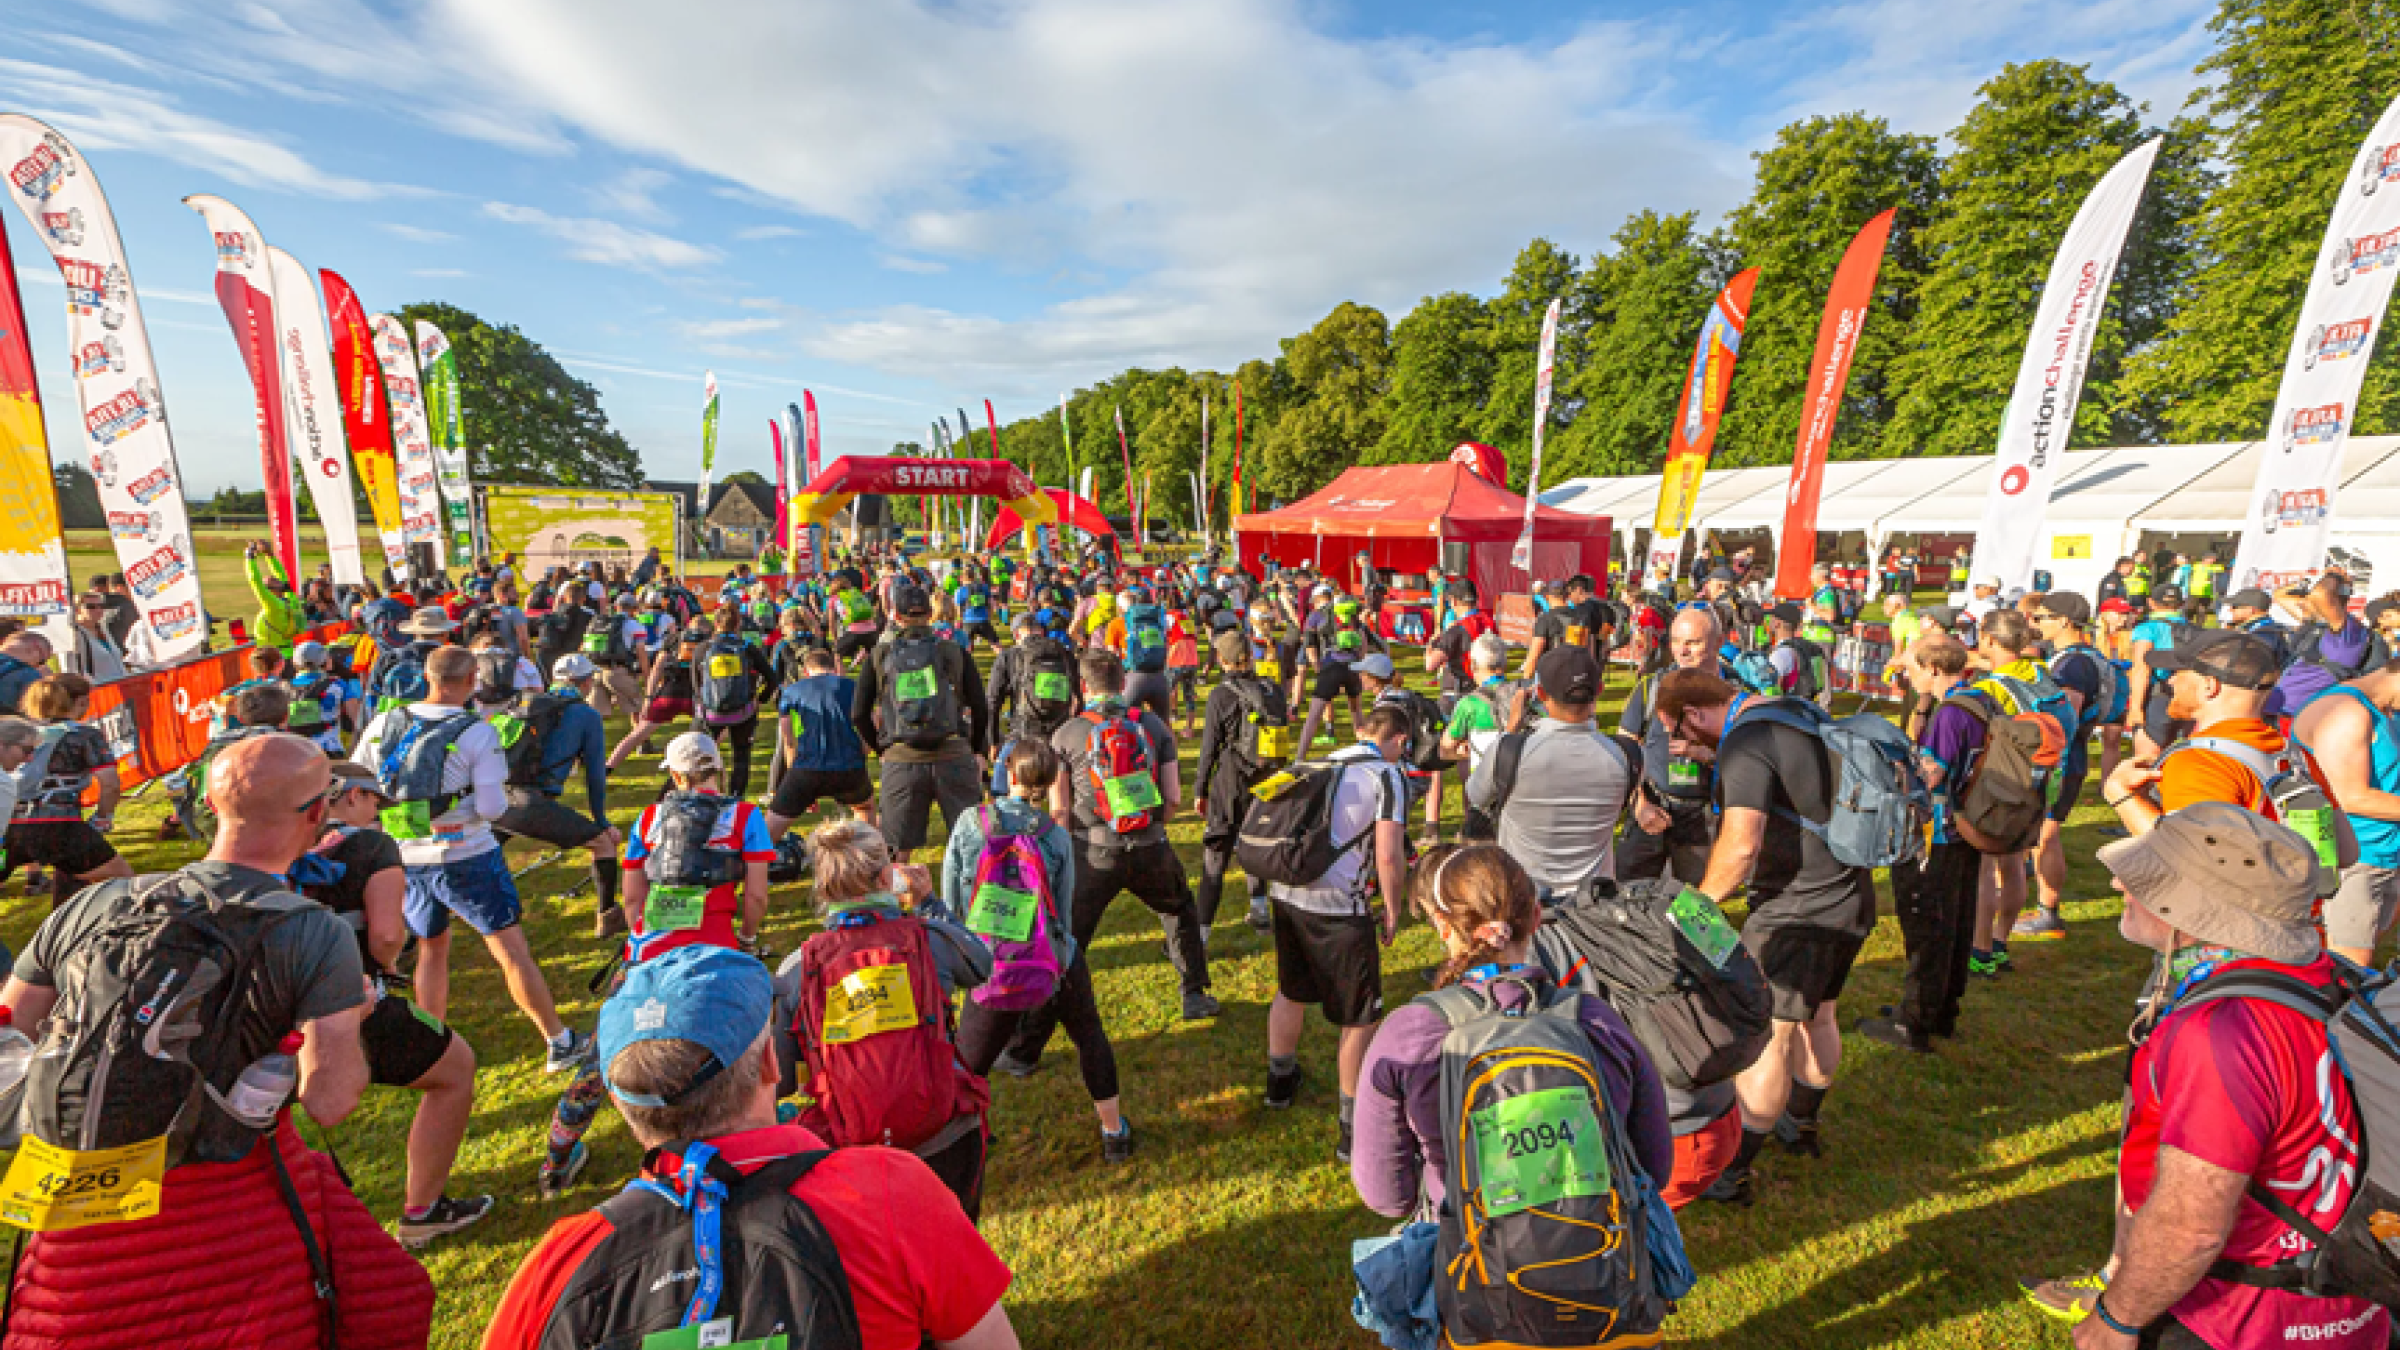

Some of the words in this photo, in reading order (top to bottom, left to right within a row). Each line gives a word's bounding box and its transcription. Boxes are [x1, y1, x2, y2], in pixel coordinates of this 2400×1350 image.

[2029, 260, 2098, 468] actionchallenge
[896, 466, 969, 487] START
[1501, 1119, 1575, 1159] 2094
[37, 1167, 120, 1195] 4226
